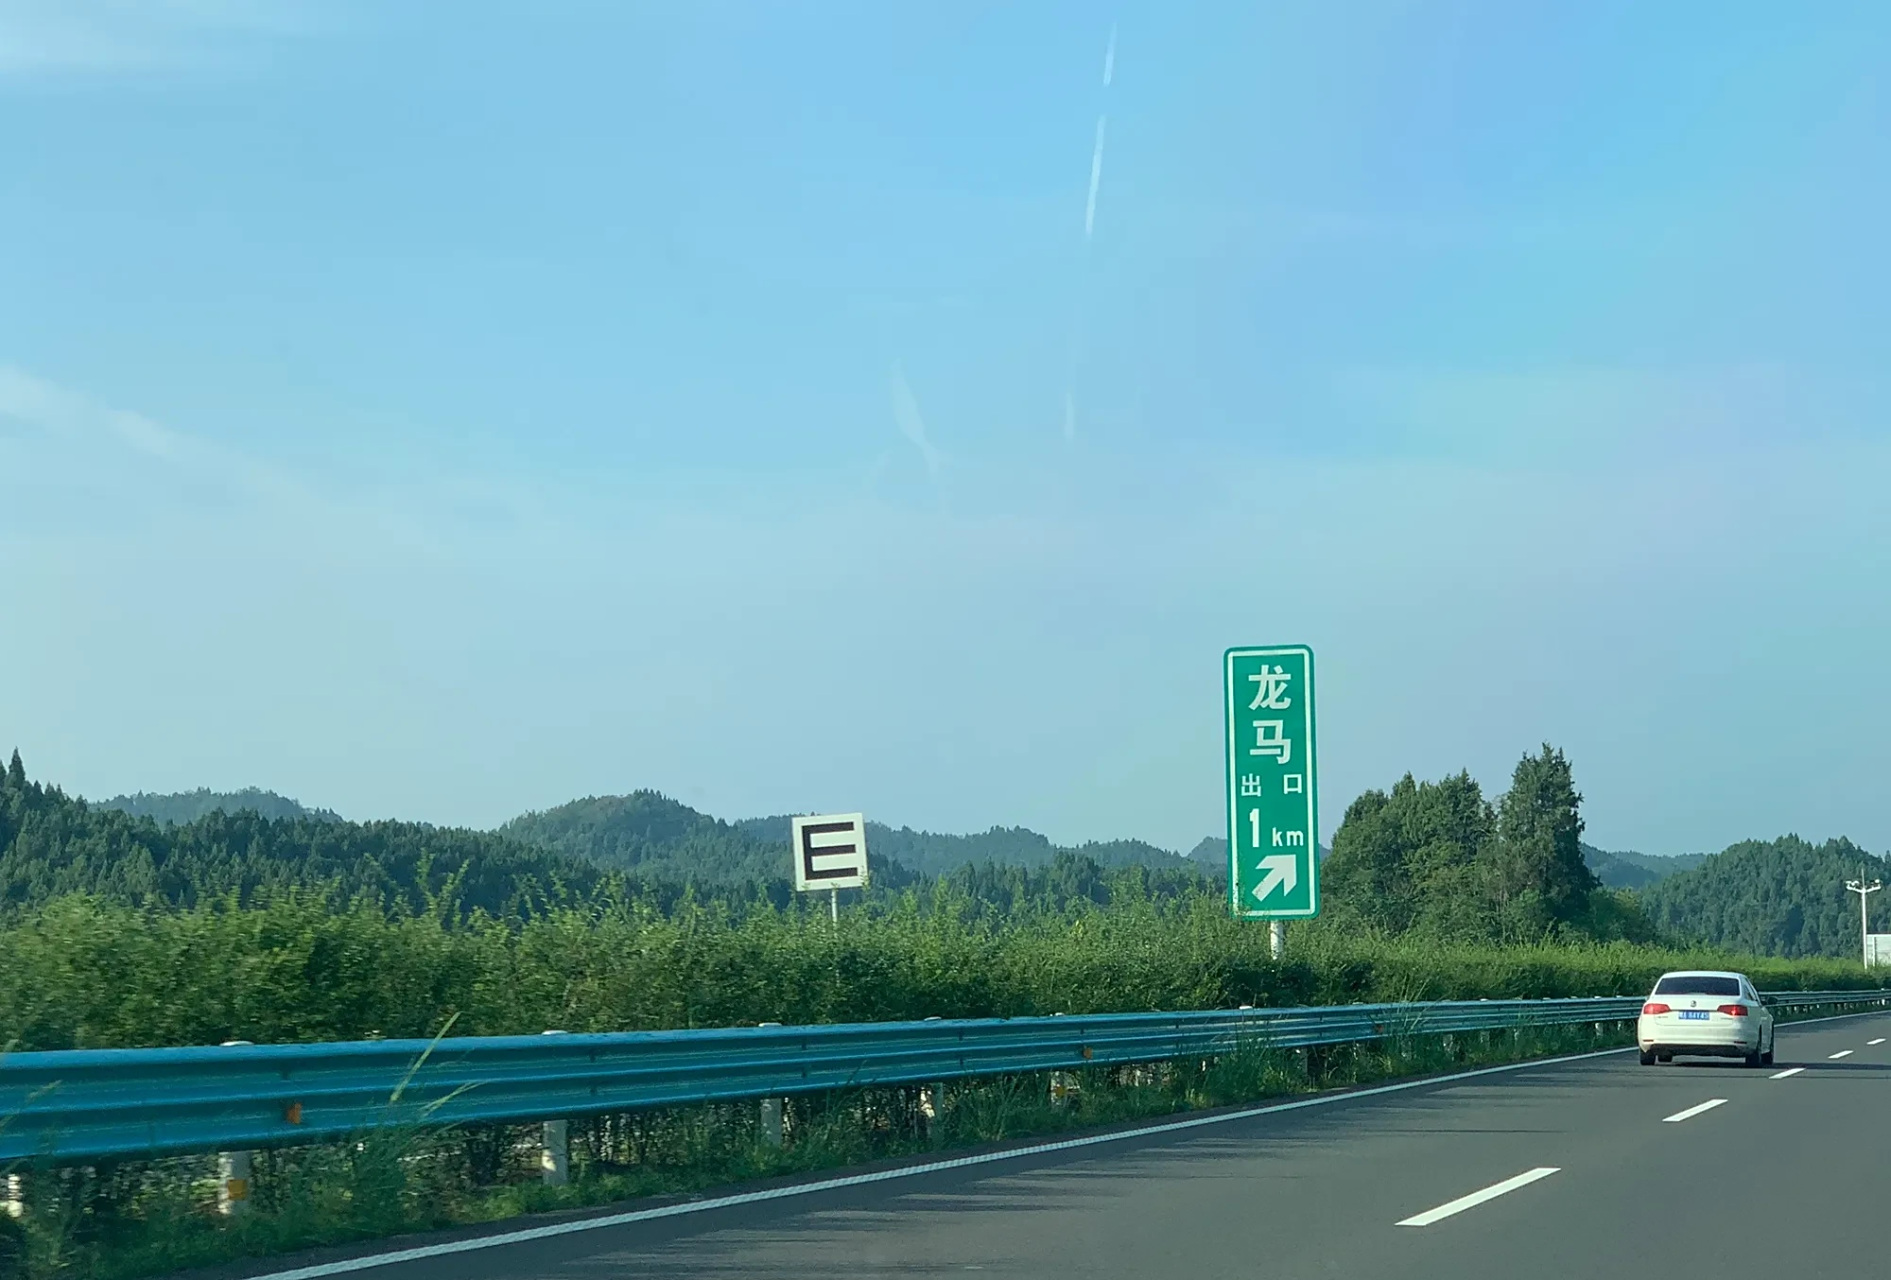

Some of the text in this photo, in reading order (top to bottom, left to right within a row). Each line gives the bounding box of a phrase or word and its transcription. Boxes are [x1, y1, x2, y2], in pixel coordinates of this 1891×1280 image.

[1248, 664, 1292, 764] 龙马
[1241, 773, 1303, 797] 出口
[1249, 808, 1304, 848] 1 km
